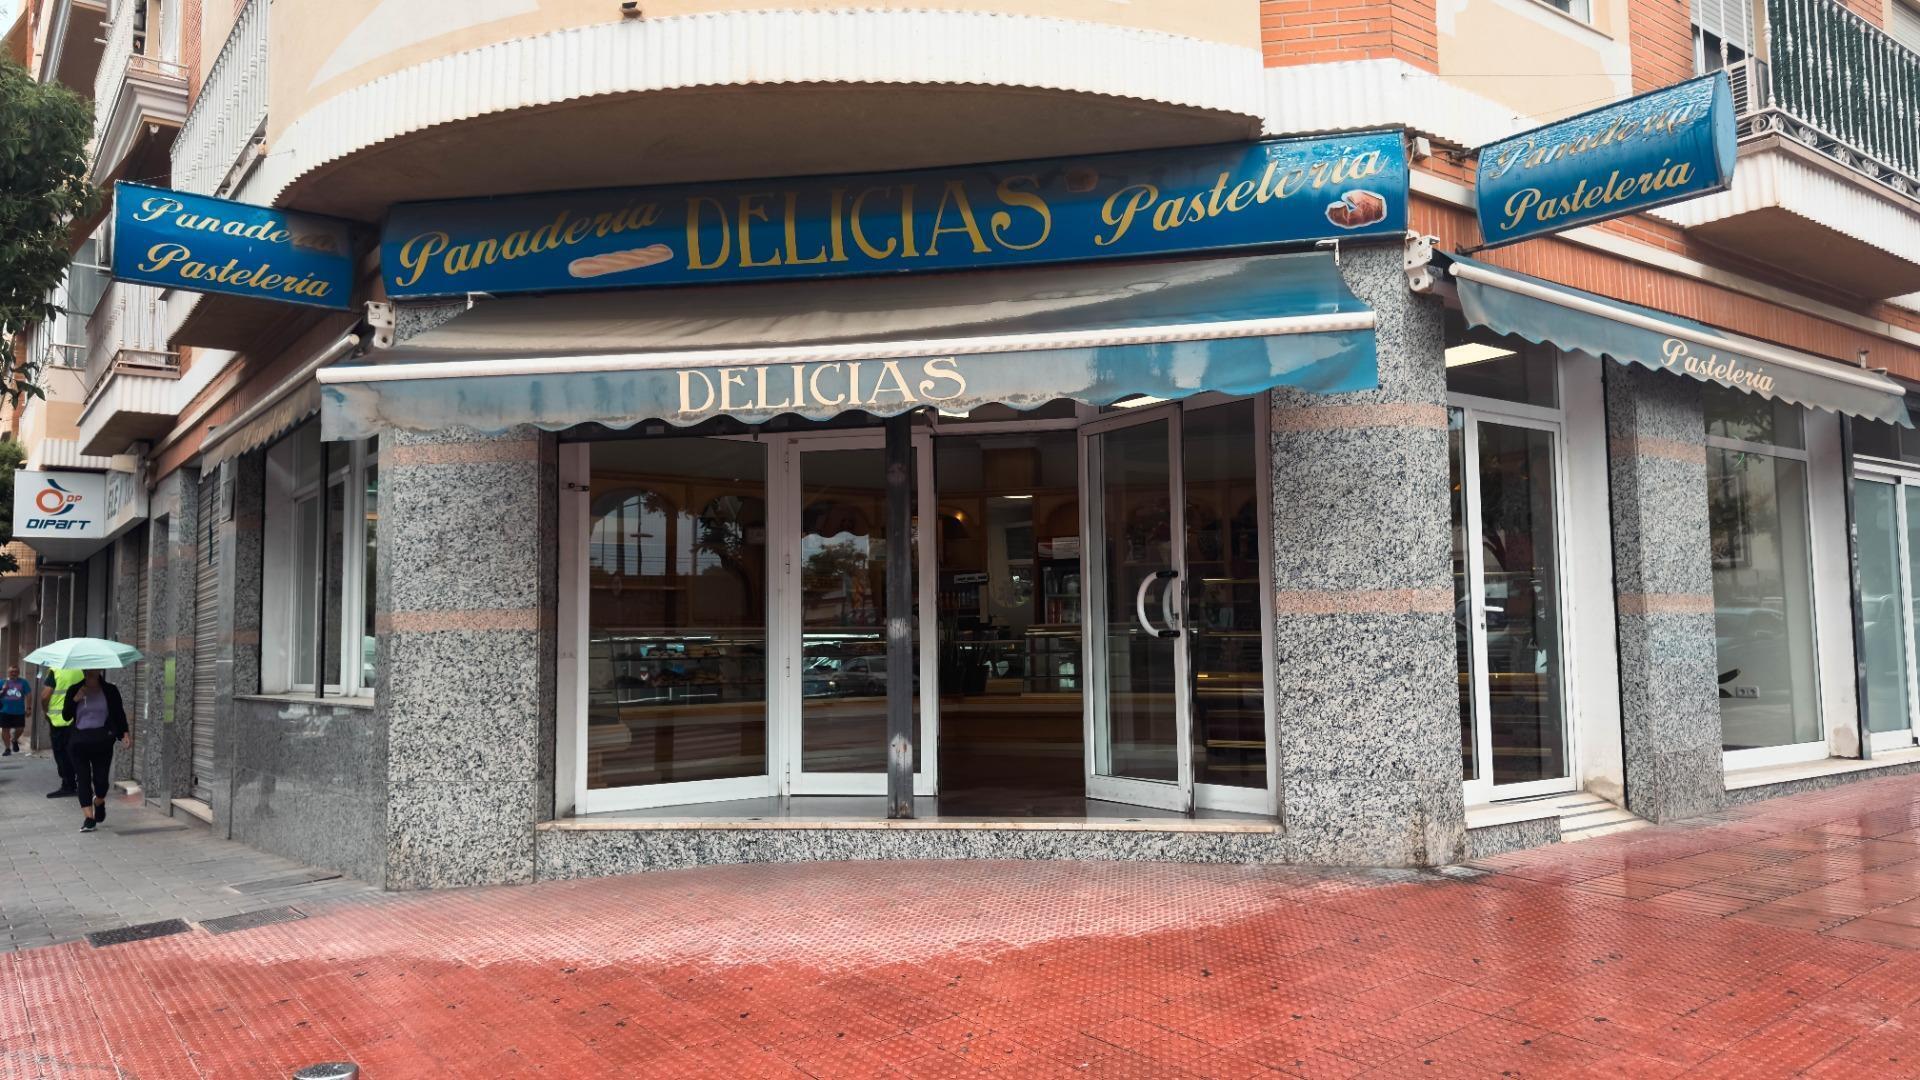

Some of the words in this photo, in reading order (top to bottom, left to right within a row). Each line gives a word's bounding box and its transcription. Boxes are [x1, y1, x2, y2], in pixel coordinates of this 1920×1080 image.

[685, 175, 1052, 271] DELICIAS
[1094, 147, 1390, 246] Pastelería
[1500, 158, 1695, 231] Pastelería
[133, 197, 337, 252] Panade
[138, 242, 333, 297] Pastelería
[676, 356, 967, 414] DELICIAS
[1660, 338, 1775, 391] Pastelería
[66, 494, 83, 503] DP
